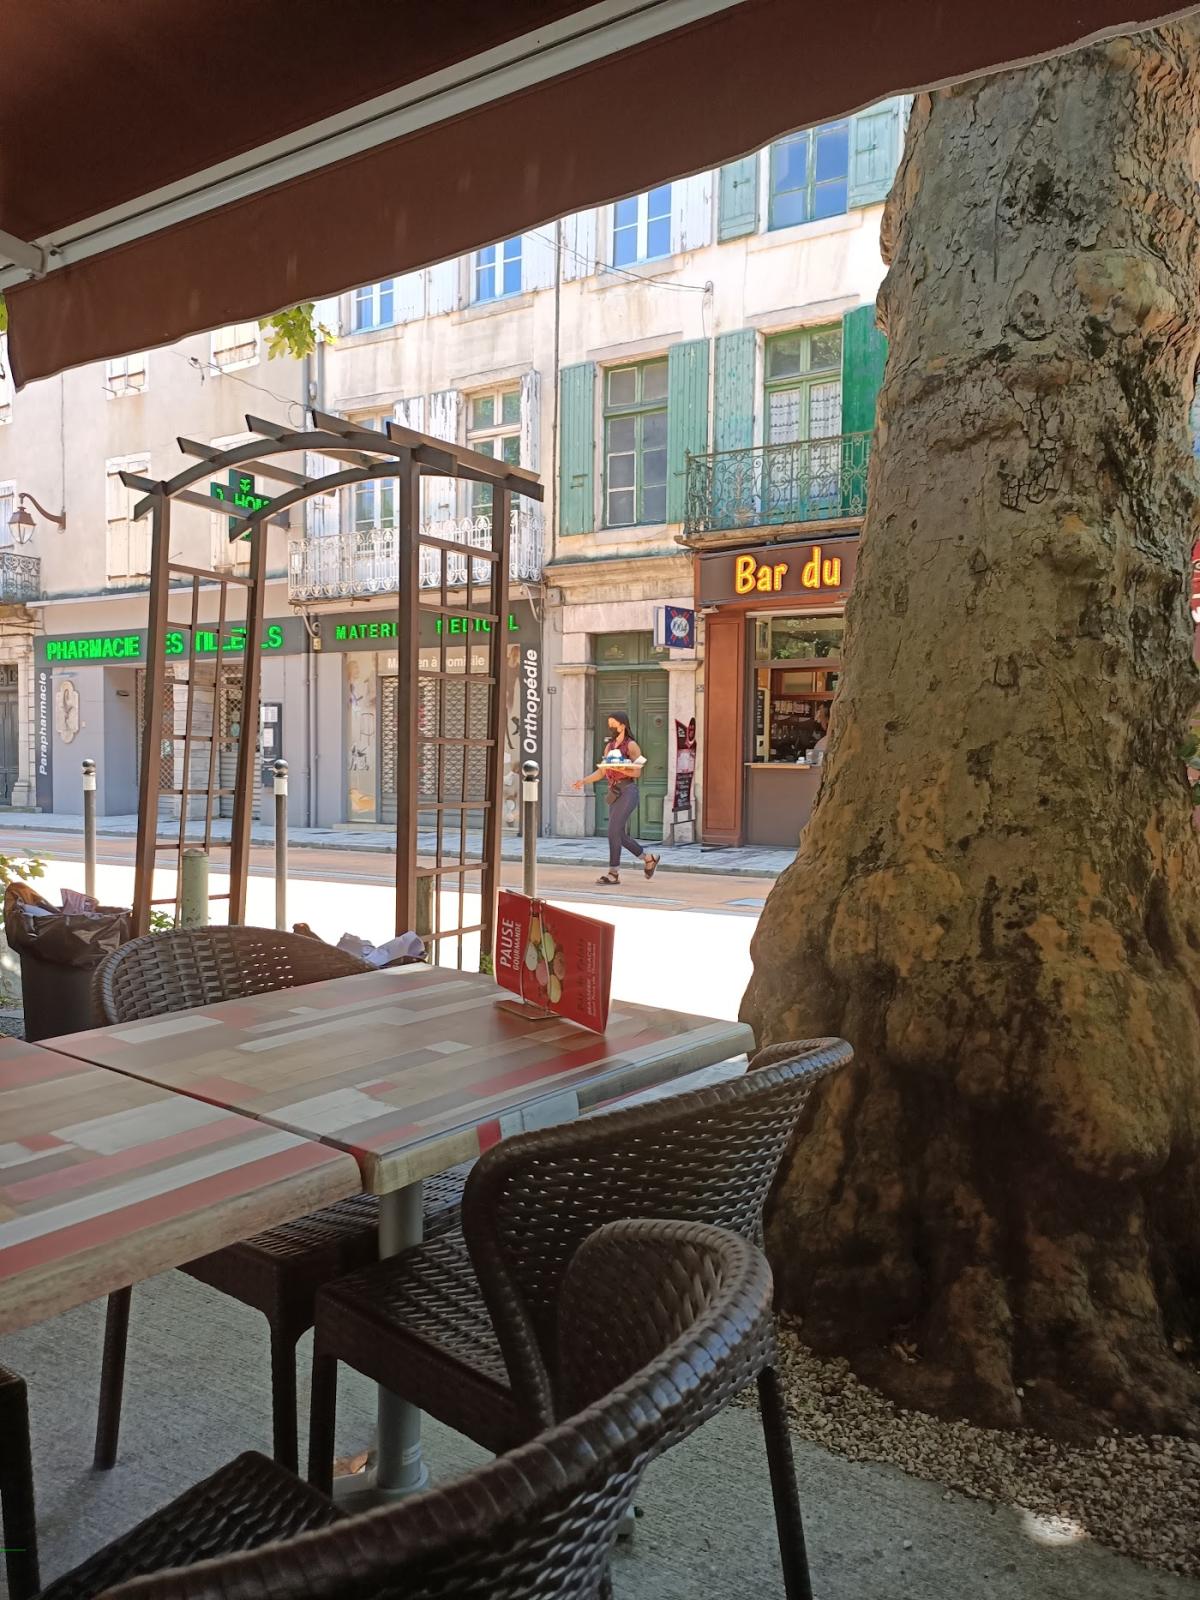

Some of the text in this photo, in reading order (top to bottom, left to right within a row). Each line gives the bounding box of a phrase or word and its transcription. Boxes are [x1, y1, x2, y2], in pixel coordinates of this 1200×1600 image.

[735, 545, 841, 594] Bar du
[46, 636, 140, 660] PHARMACIE
[39, 672, 48, 775] Parapharmacie
[523, 649, 541, 754] Orthopédie
[500, 917, 515, 968] PAUSE
[512, 922, 521, 971] GOURMANDE
